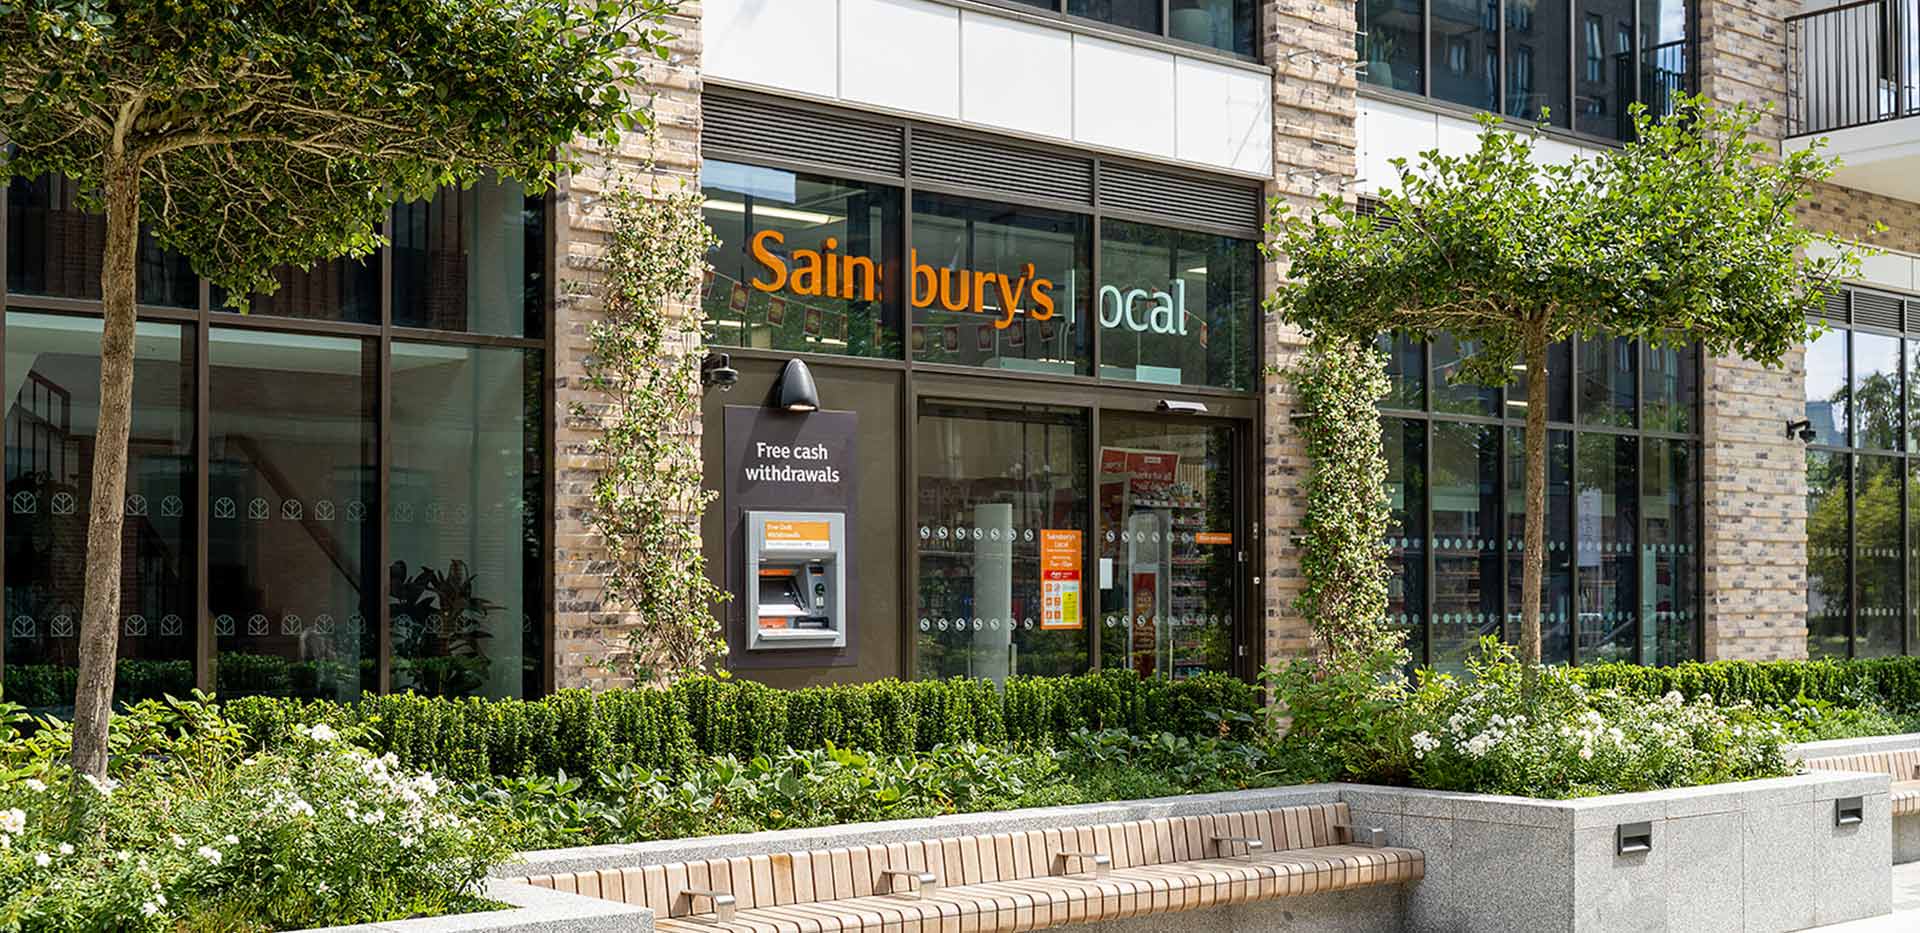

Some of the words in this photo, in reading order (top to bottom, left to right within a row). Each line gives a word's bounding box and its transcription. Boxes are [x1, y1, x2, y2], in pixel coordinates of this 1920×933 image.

[751, 230, 1055, 329] Sainbury's
[756, 442, 791, 459] Free
[793, 443, 828, 460] cash
[745, 464, 840, 483] withdrawals
